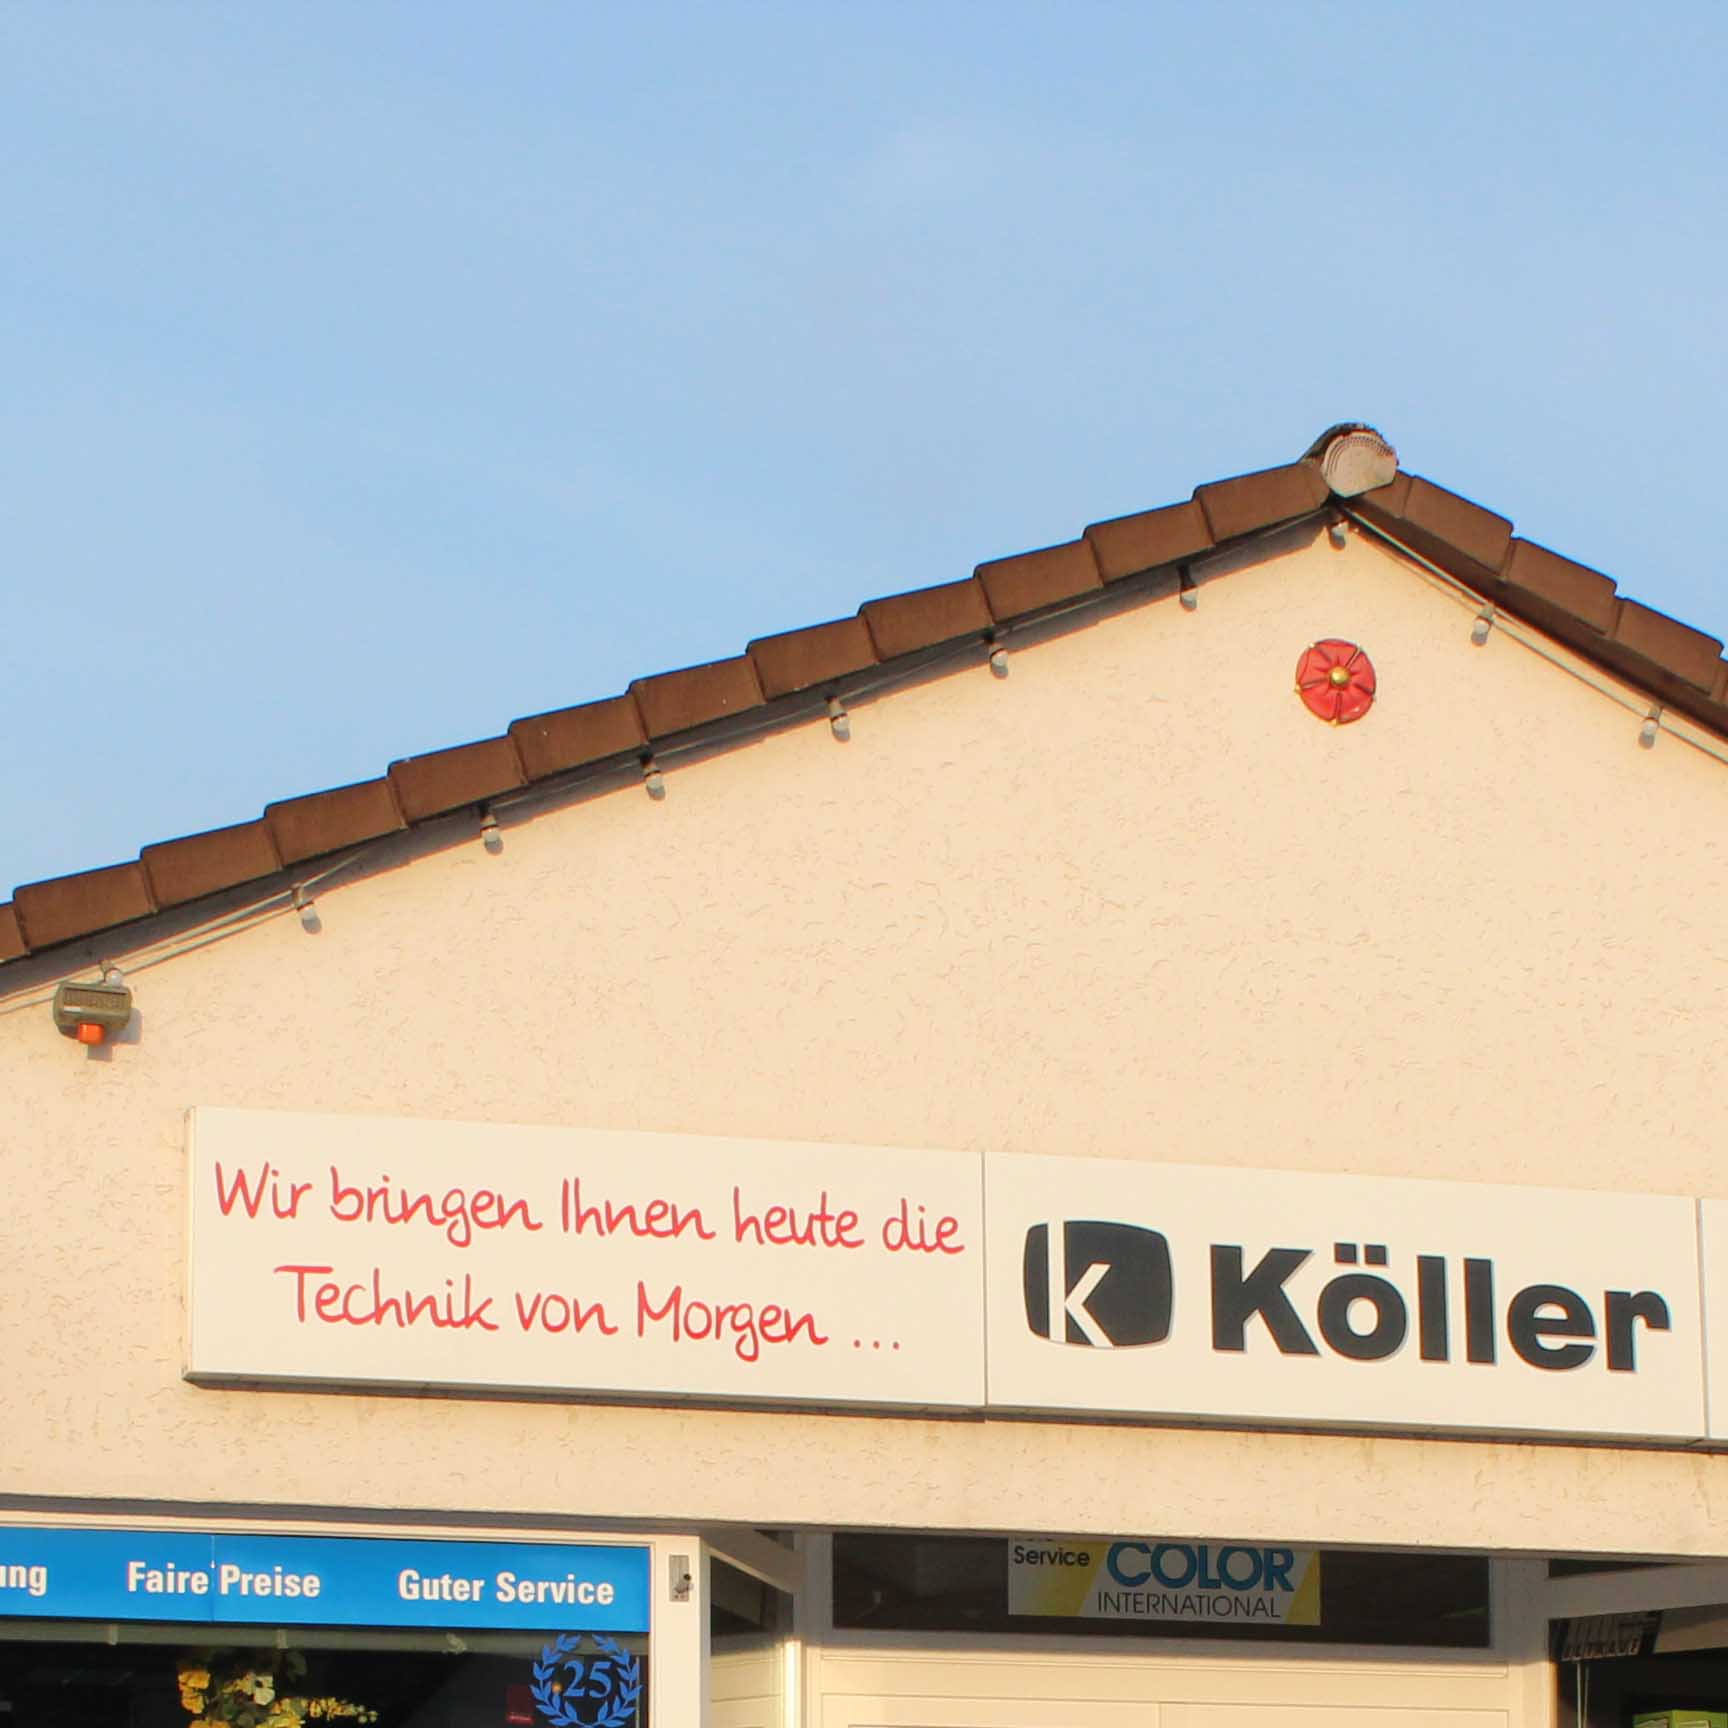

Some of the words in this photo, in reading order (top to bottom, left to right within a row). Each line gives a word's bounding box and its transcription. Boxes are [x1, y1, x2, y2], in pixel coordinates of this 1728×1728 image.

[214, 1161, 312, 1220] Wir
[330, 1166, 543, 1247] bringen
[561, 1178, 716, 1240] Ihnen
[733, 1187, 865, 1247] heute
[882, 1198, 965, 1255] die
[274, 1264, 499, 1332] Technik
[514, 1290, 619, 1336] von
[637, 1281, 830, 1363] Morgen
[1210, 1242, 1671, 1373] Köller
[127, 1560, 209, 1595] Faire
[220, 1564, 321, 1598] Preise
[398, 1569, 484, 1603] Guter
[496, 1572, 615, 1606] Service
[1013, 1545, 1091, 1568] Service
[1106, 1541, 1295, 1592] COLOR
[1097, 1591, 1281, 1618] INTERNATIONAL
[563, 1660, 612, 1698] 25
